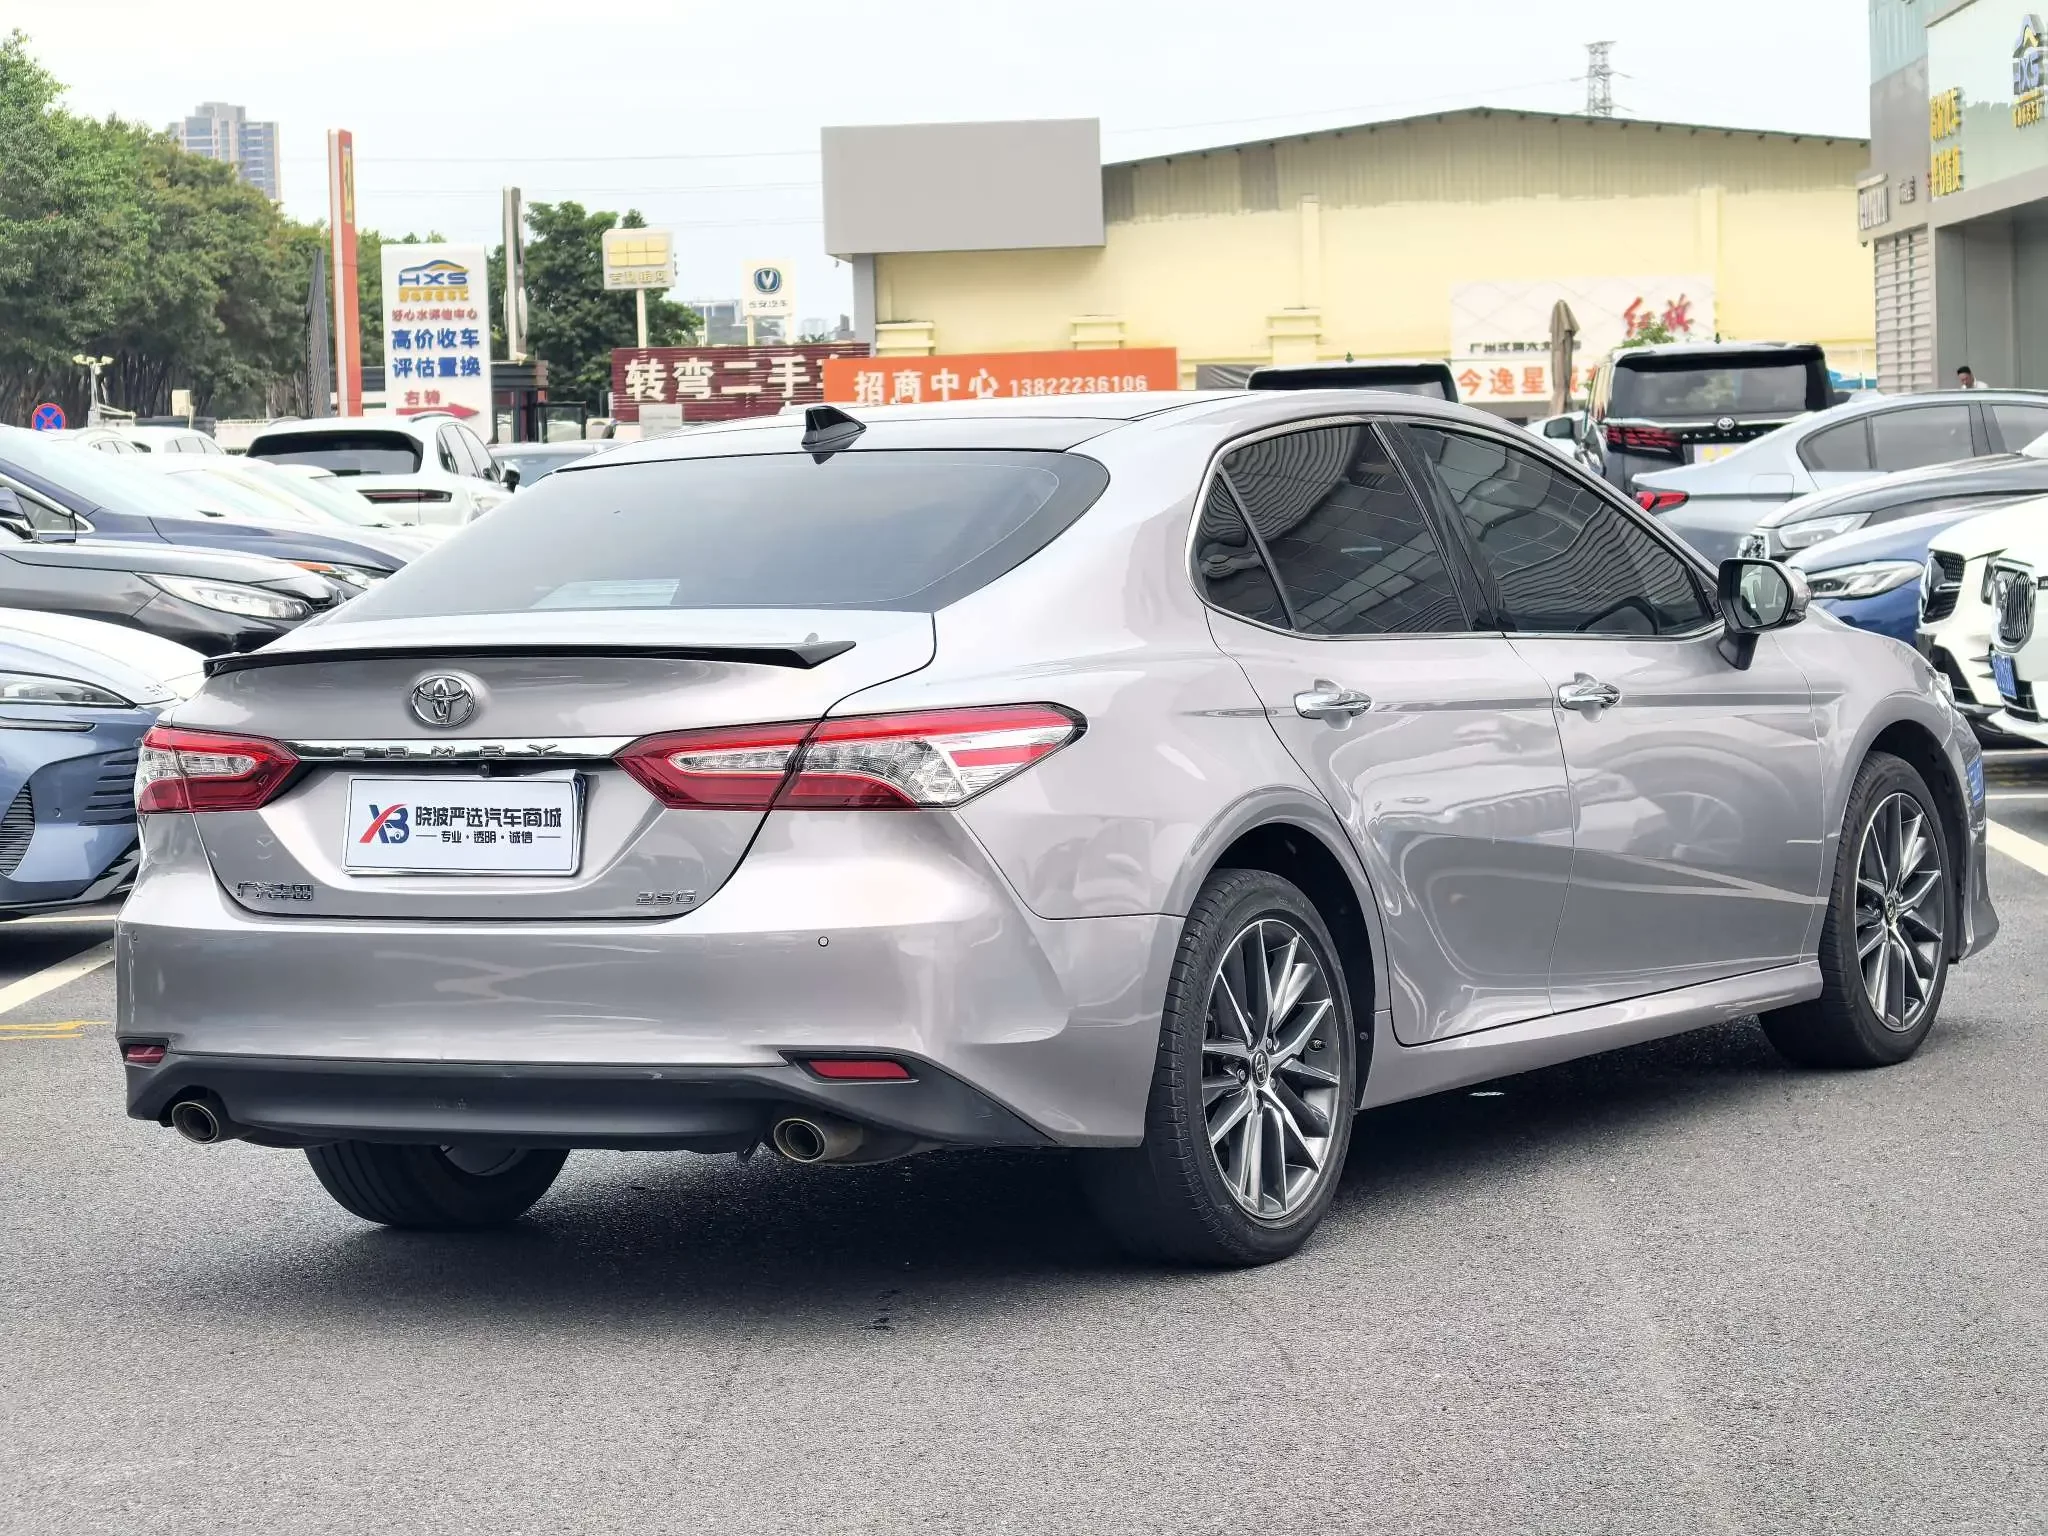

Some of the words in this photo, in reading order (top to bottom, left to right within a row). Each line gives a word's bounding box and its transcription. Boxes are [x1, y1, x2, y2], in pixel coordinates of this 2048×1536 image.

[399, 272, 468, 286] HXS
[392, 328, 480, 349] 高价收车
[392, 356, 481, 378] 评估置换
[624, 354, 838, 401] 转弯二手
[854, 367, 998, 405] 招商中心
[343, 743, 558, 760] CAMRY
[415, 806, 562, 828] 晓波严选汽车商城
